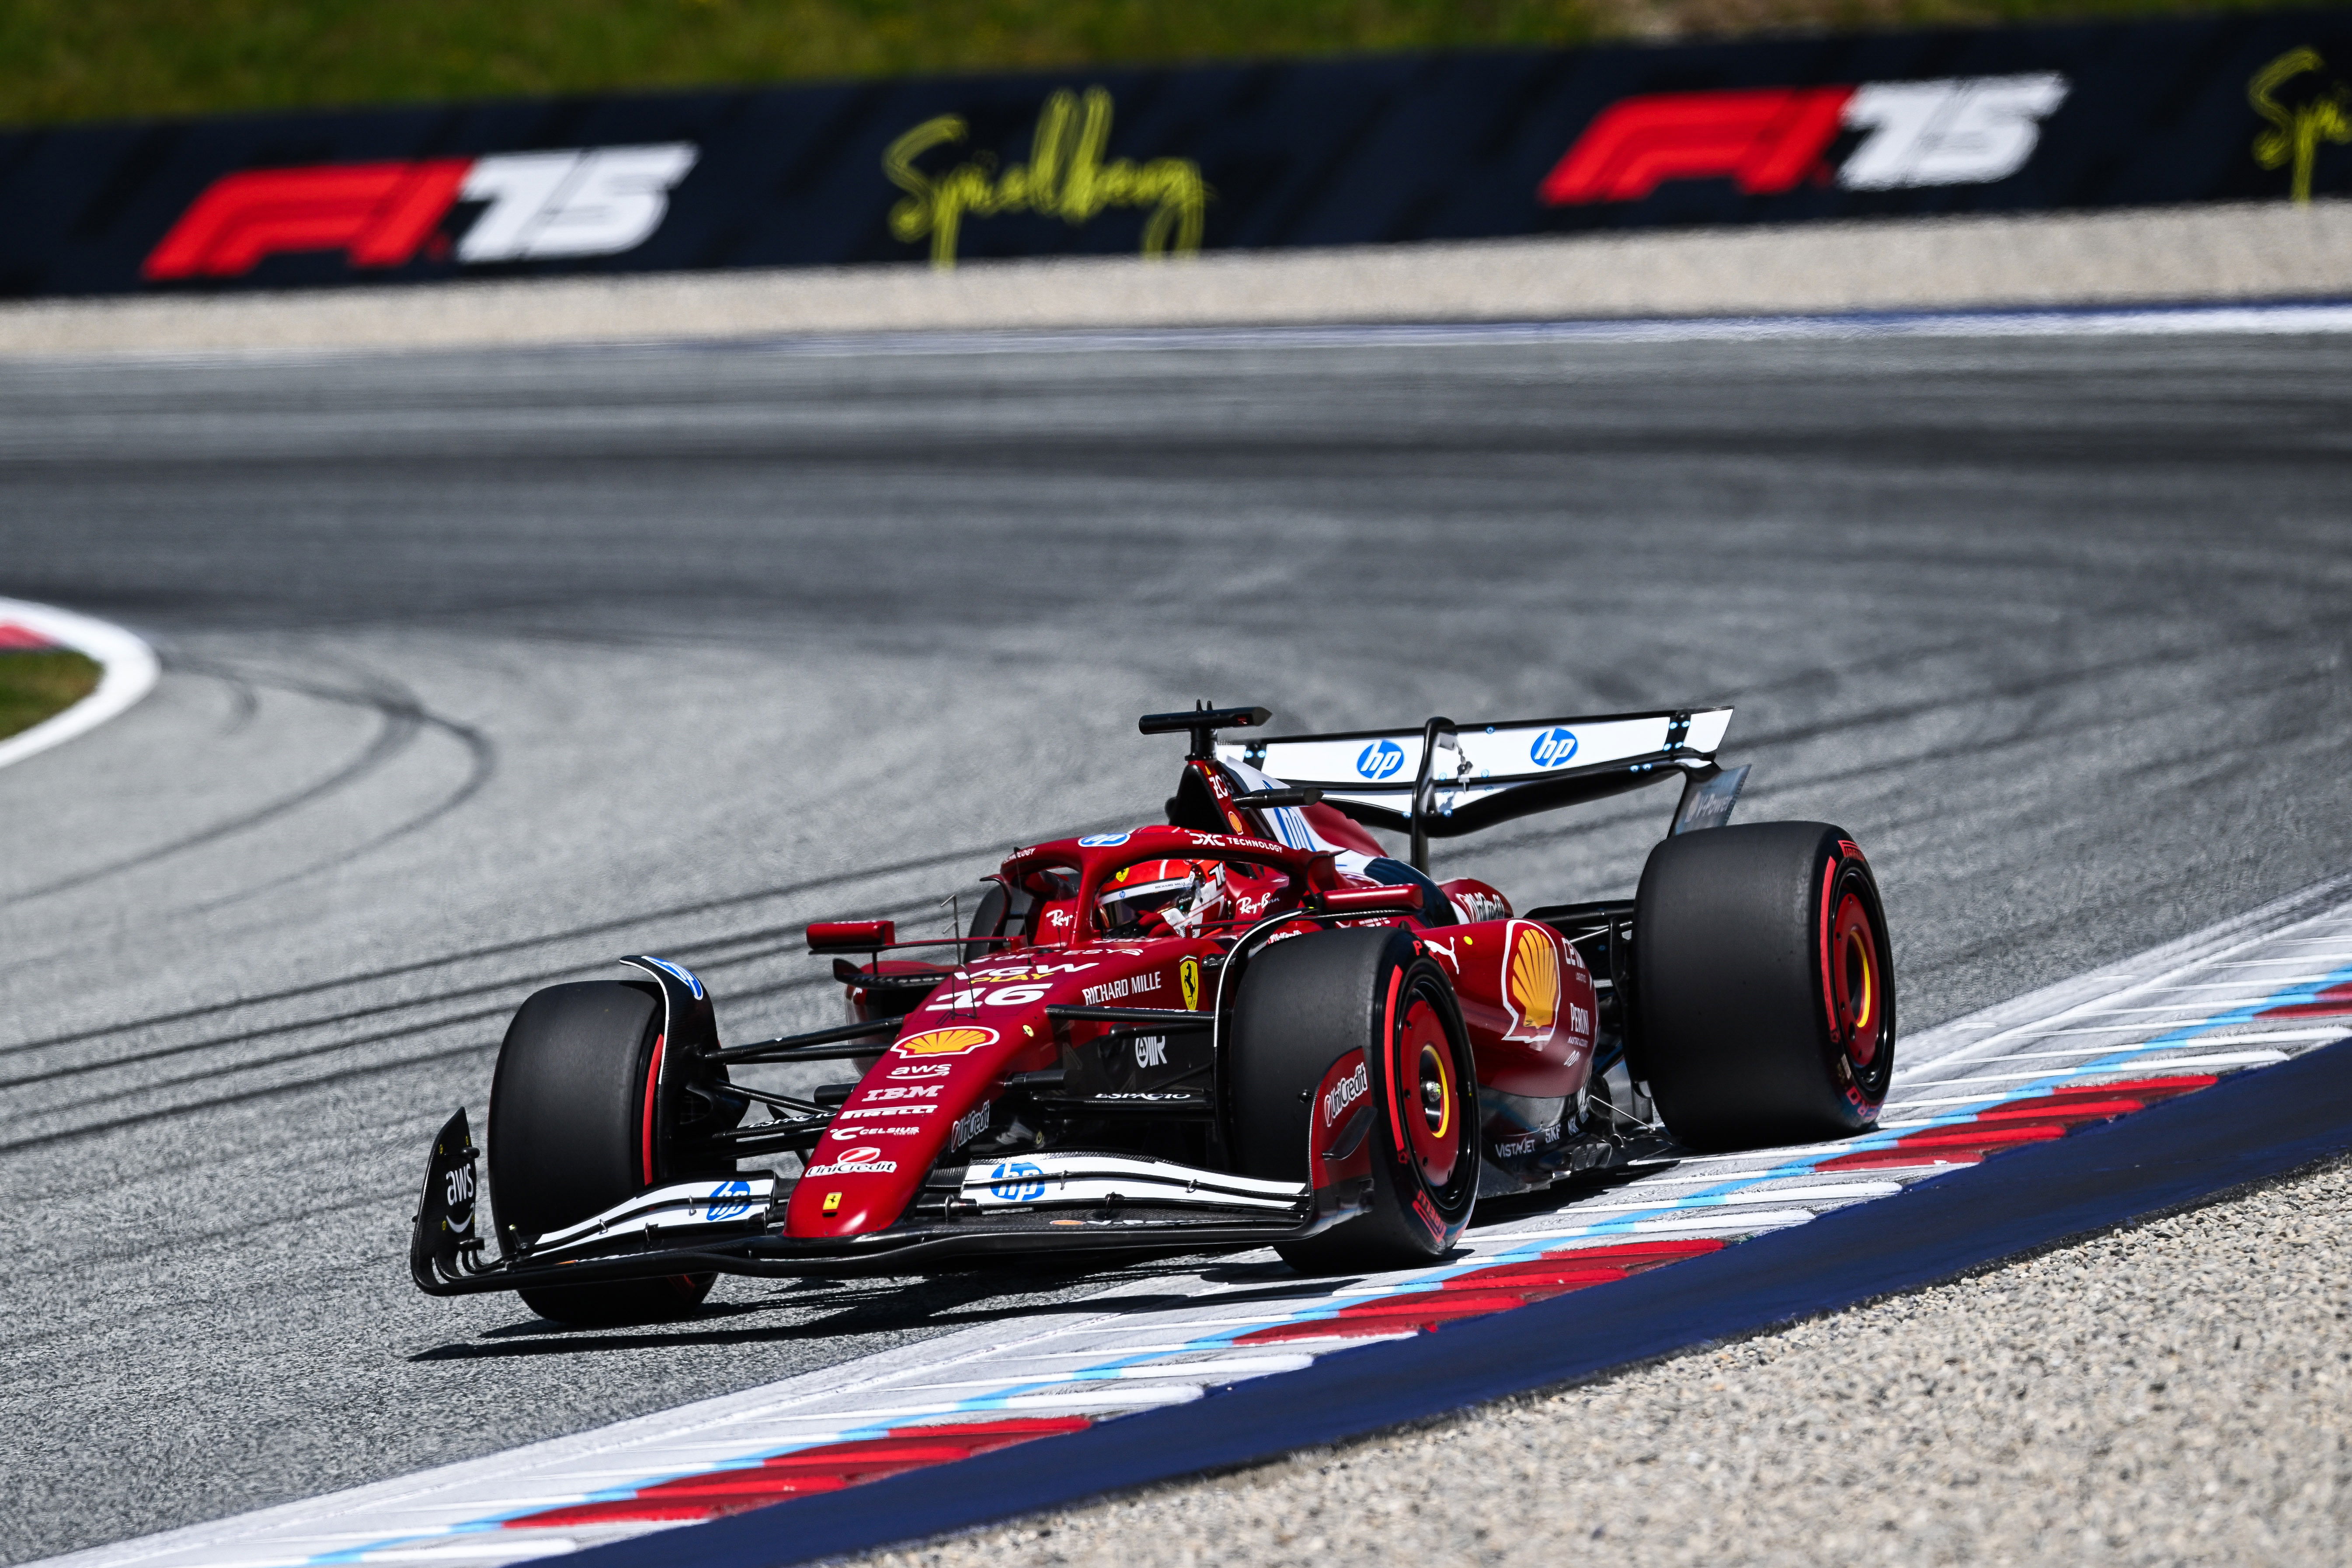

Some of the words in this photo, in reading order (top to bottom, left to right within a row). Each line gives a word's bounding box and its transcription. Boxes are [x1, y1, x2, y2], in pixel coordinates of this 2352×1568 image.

[1359, 740, 1403, 779] hp
[1532, 728, 1577, 767] hp
[1189, 833, 1225, 846] DXC
[1226, 837, 1282, 853] TECHNOLOGY
[954, 963, 1100, 980] VGW
[968, 973, 1055, 984] PLAY
[925, 983, 1053, 1011] 16
[1082, 979, 1128, 1005] RICHARD
[1131, 971, 1162, 994] MILLE
[889, 1064, 952, 1077] aws
[861, 1085, 944, 1102] IBM
[1331, 1064, 1367, 1117] UniCredit
[839, 1105, 938, 1119] PIRELLI
[958, 1100, 990, 1147] UniCredit
[859, 1126, 919, 1135] CELSIUS
[1545, 1123, 1561, 1144] SKF
[806, 1162, 896, 1176] UniCredit
[446, 1163, 473, 1206] aws
[993, 1163, 1043, 1202] hp
[707, 1181, 750, 1221] hp
